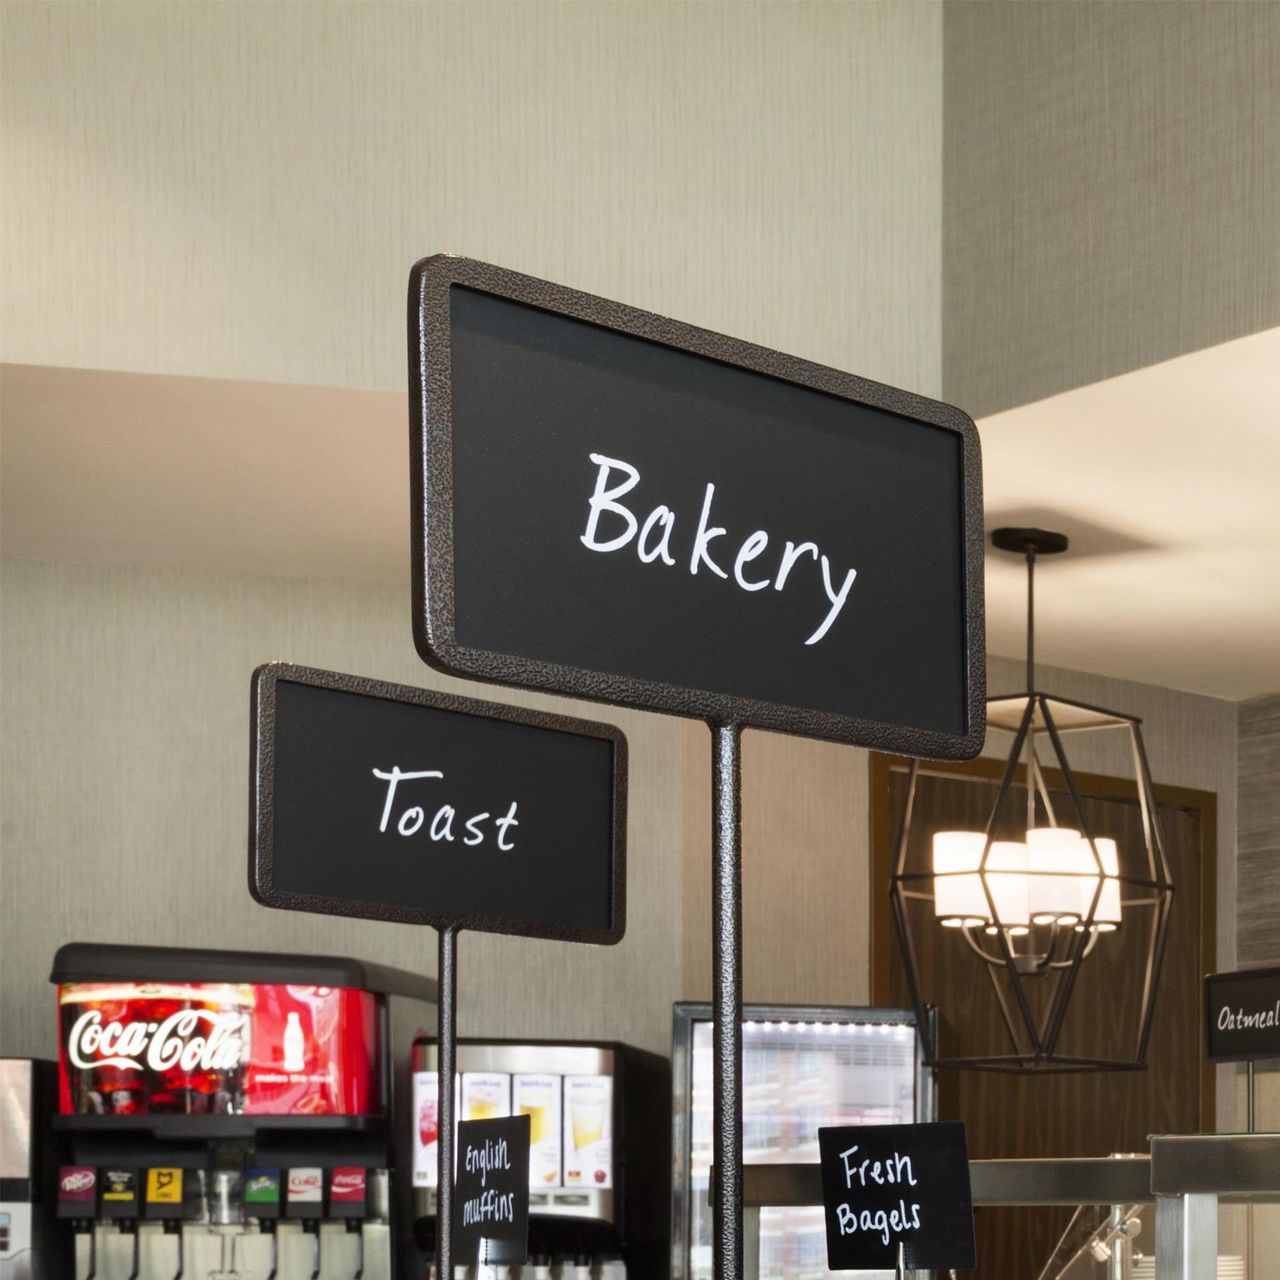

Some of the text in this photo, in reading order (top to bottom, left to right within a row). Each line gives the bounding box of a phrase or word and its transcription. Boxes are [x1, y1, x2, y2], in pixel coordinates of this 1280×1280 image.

[579, 452, 857, 646] Bakery
[372, 765, 520, 852] Toast
[1217, 1000, 1280, 1031] Oatmeal
[68, 1008, 243, 1071] Coca-Cola
[465, 1138, 511, 1187] English
[838, 1145, 918, 1189] Fresh
[462, 1189, 515, 1227] muffins
[836, 1200, 921, 1246] Bagels
